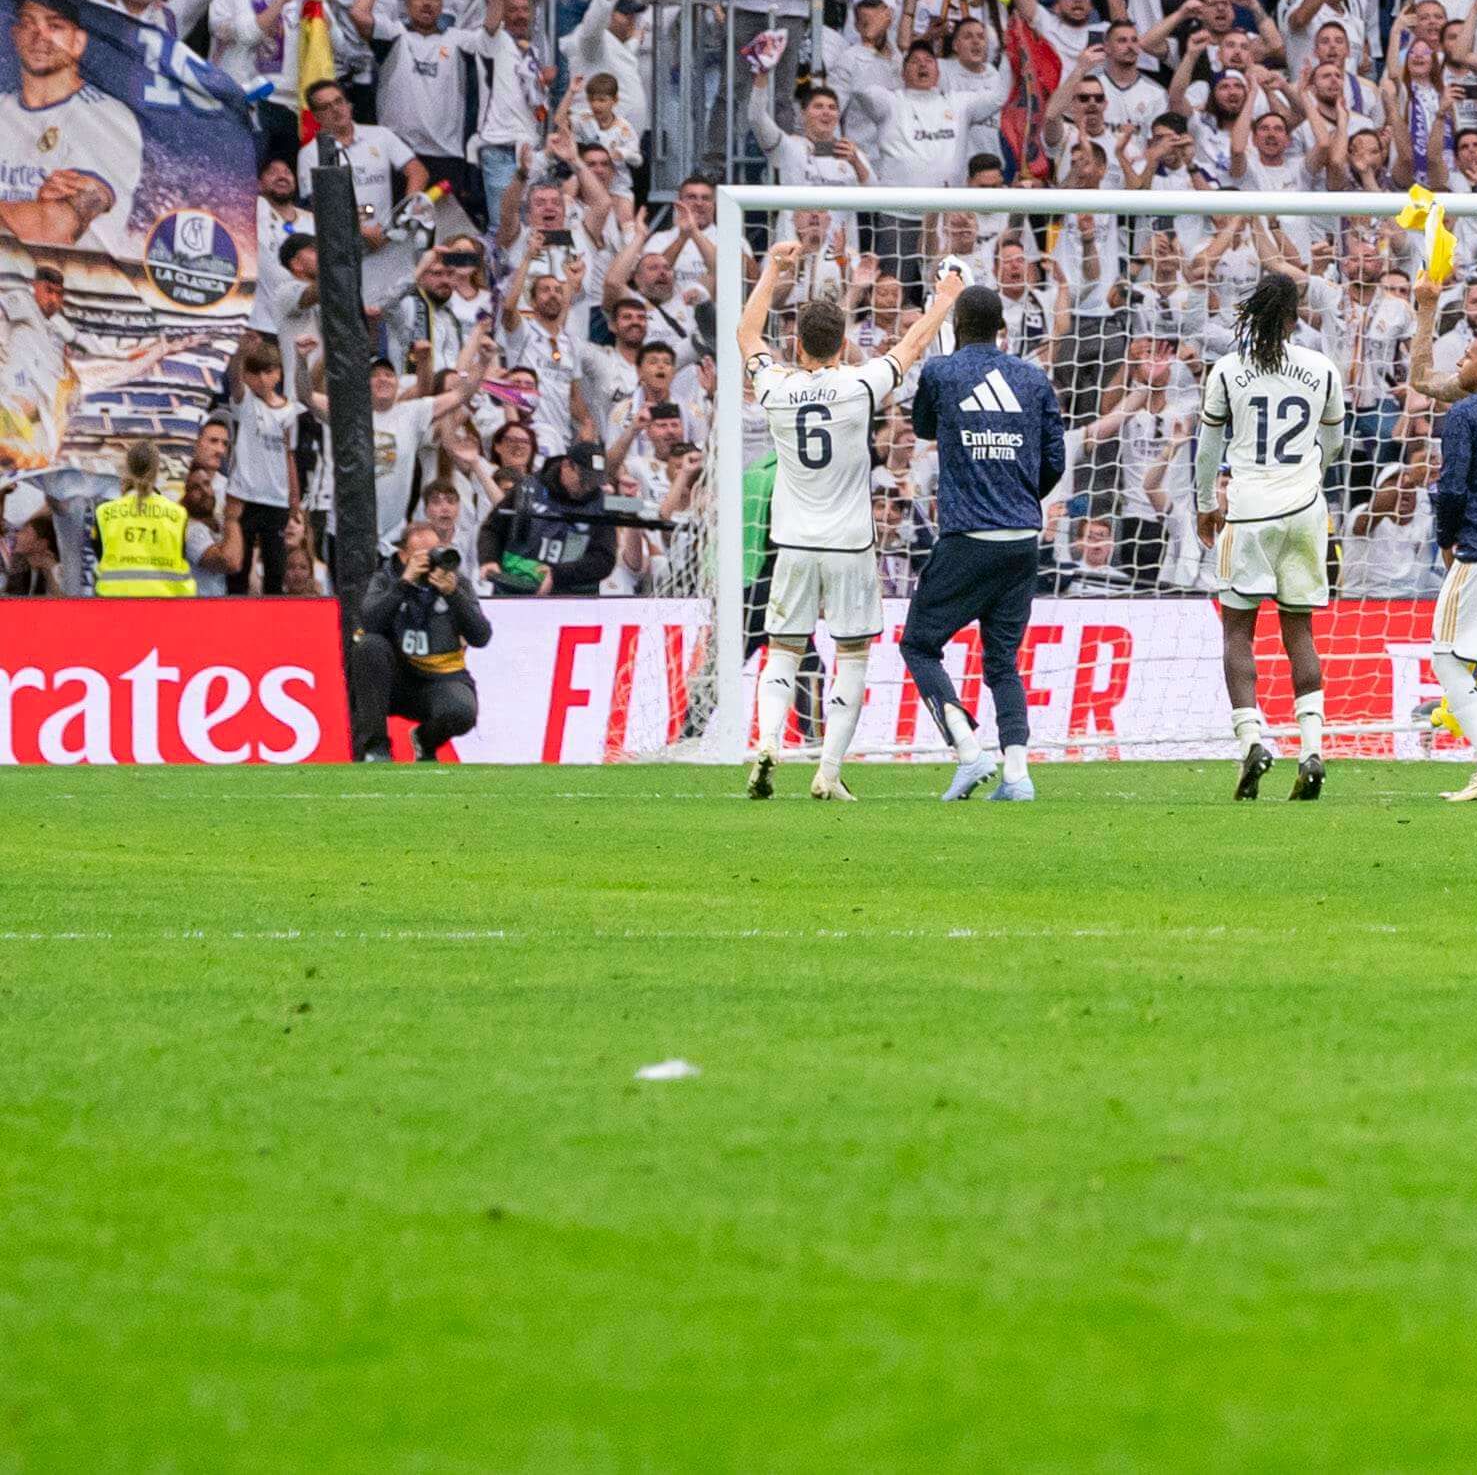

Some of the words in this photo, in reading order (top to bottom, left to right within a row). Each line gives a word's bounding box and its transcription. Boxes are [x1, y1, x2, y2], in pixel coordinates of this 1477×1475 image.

[789, 387, 837, 404] NACHO
[796, 404, 833, 470] 6
[961, 428, 1024, 447] Emirates
[1249, 395, 1310, 465] 12
[103, 503, 181, 523] SEGURIDAD
[124, 526, 158, 543] 671
[538, 537, 561, 562] 19
[402, 628, 429, 655] 60
[0, 647, 318, 763] rates
